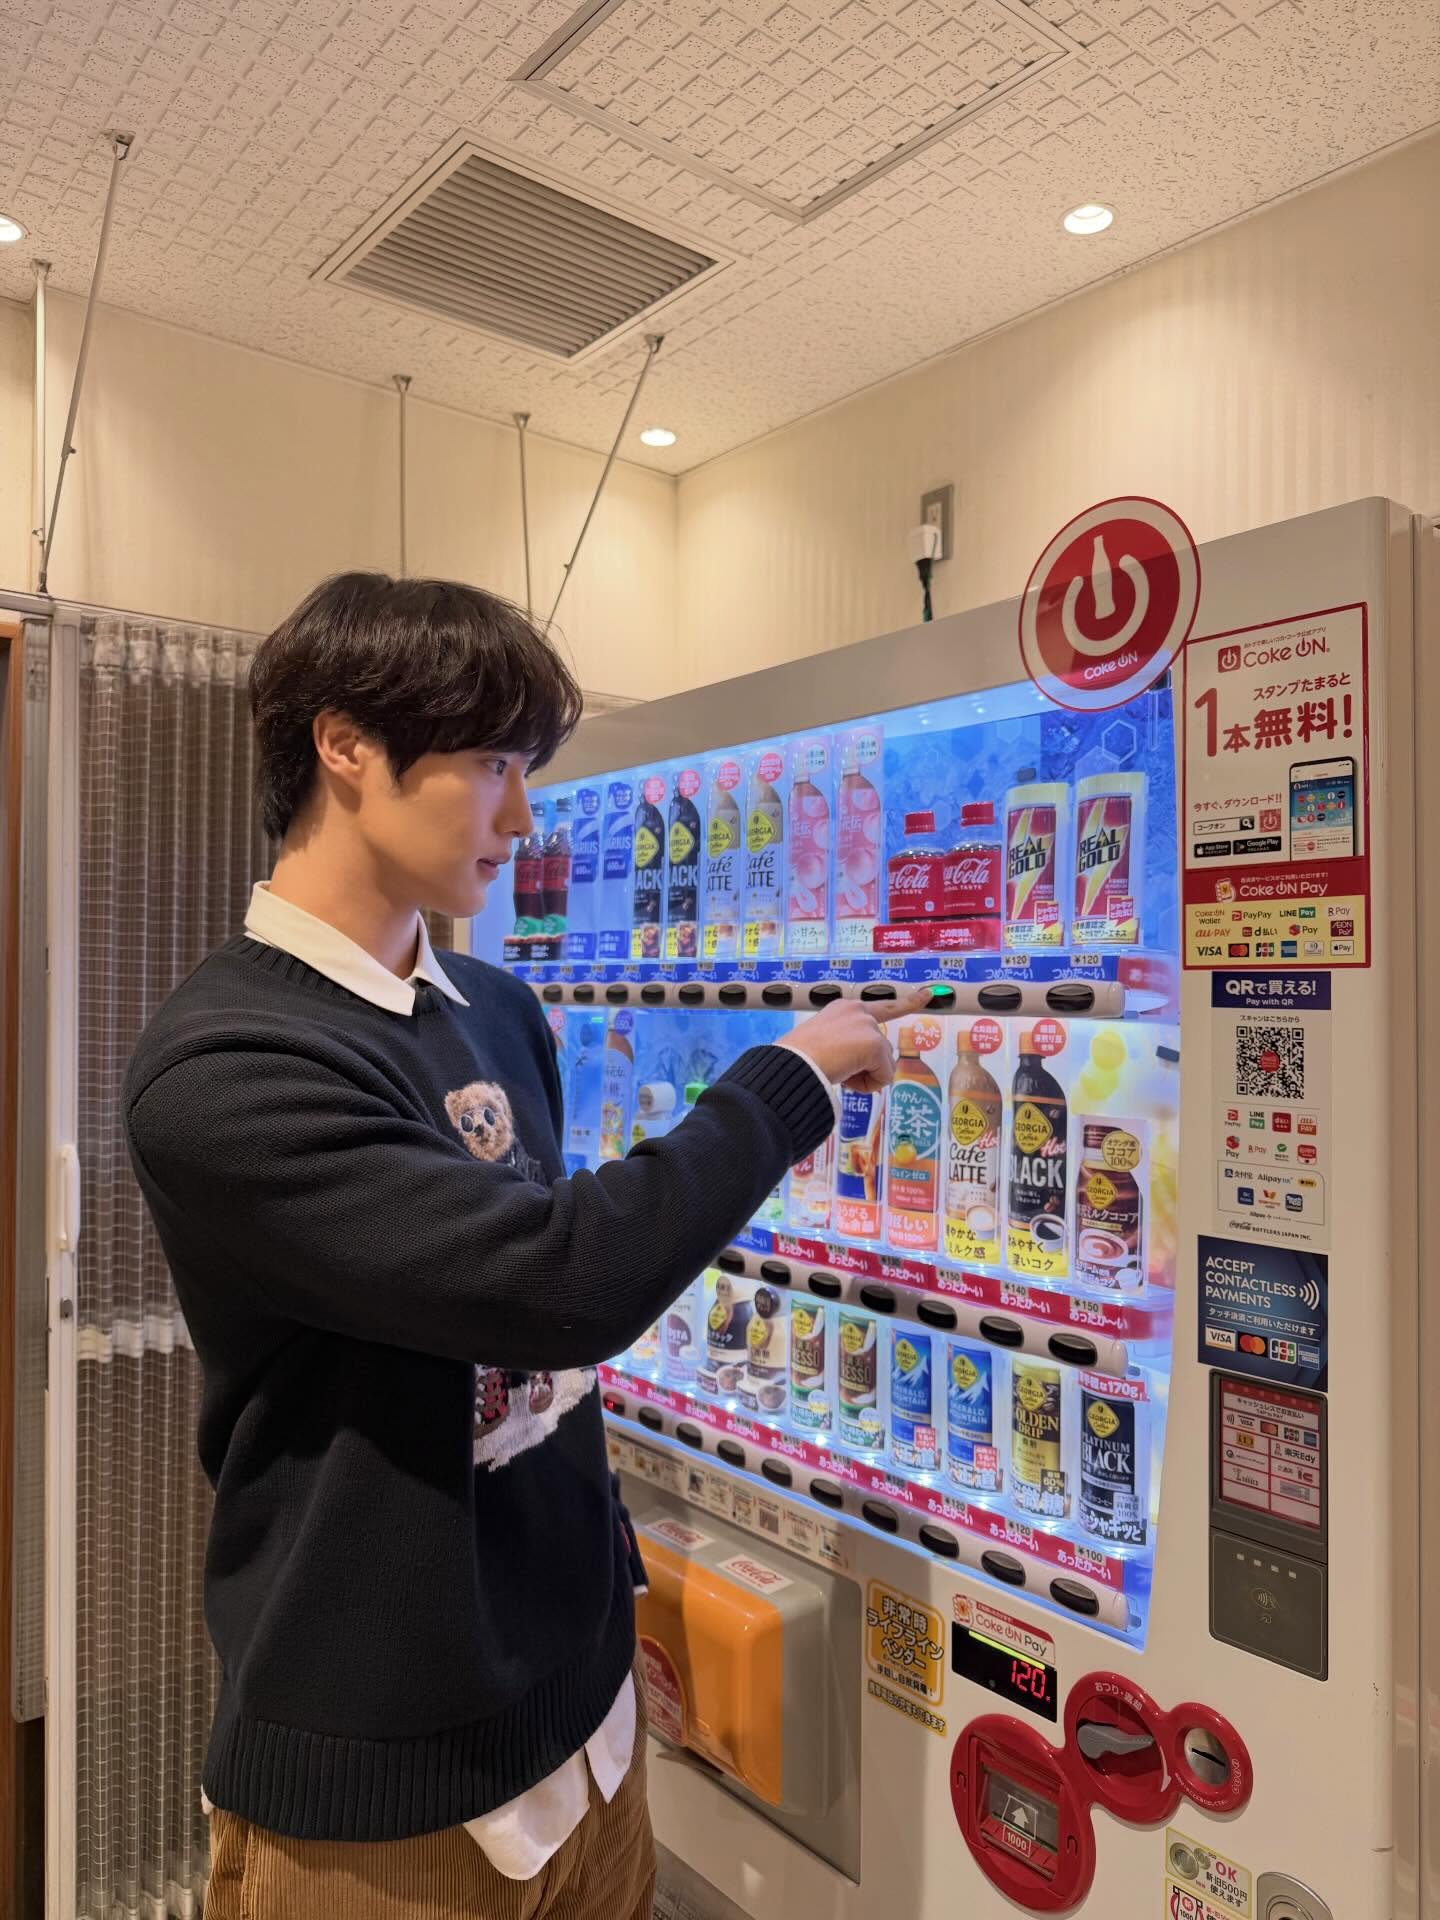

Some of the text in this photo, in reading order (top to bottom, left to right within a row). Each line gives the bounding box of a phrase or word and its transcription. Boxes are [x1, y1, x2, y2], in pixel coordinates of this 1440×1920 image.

[1083, 651, 1138, 680] Coke ON
[1244, 647, 1292, 668] Coke
[1253, 672, 1351, 701] スタンプたまると
[1196, 822, 1226, 832] コークオン
[1080, 826, 1121, 853] REAL
[1246, 838, 1279, 847] Google Play
[1009, 835, 1047, 861] REAL
[1008, 852, 1046, 880] GOLD
[1079, 843, 1121, 873] GOLD
[1239, 881, 1328, 897] Coke ON Pay
[1243, 911, 1272, 920] PayPay
[1300, 909, 1314, 917] Pay
[1336, 906, 1351, 916] Pay
[1214, 928, 1231, 937] PAY
[1302, 926, 1318, 936] Pay
[1196, 946, 1222, 956] VISA
[942, 959, 963, 967] ¥120
[1005, 954, 1028, 965] ¥120
[1074, 955, 1099, 965] ¥120
[1225, 979, 1316, 996] QRで買える!
[1246, 998, 1294, 1006] Pay with QR
[1240, 1014, 1301, 1023] スキャンはこちらから
[1106, 1146, 1136, 1158] ココア
[1225, 1150, 1240, 1159] Pay
[1110, 1156, 1134, 1168] 100%
[1257, 1174, 1281, 1184] Alipay
[1253, 1226, 1280, 1236] BOTTLERS
[1282, 1231, 1299, 1239] JAPAN
[1205, 1255, 1255, 1274] ACCEPT
[939, 1270, 960, 1281] ¥150
[1005, 1283, 1026, 1296] ¥140
[1205, 1270, 1297, 1298] CONTACTLESS
[1205, 1285, 1271, 1309] PAYMENTS
[1074, 1299, 1099, 1313] ¥150
[1210, 1331, 1232, 1344] VISA
[1015, 1407, 1060, 1432] OLDEN
[1240, 1418, 1253, 1427] VISA
[1018, 1422, 1044, 1439] DRIP
[1082, 1444, 1133, 1475] BLACK
[1284, 1447, 1316, 1463] 楽天Edy
[1009, 1521, 1031, 1536] ¥120
[1088, 1511, 1142, 1541] シャキッと
[1078, 1546, 1103, 1562] ¥100
[881, 1595, 928, 1636] 非常時
[866, 1607, 944, 1660] ライフライン
[975, 1613, 1003, 1634] Coke
[1004, 1626, 1022, 1644] ON
[1024, 1634, 1047, 1657] Pay
[881, 1637, 926, 1670] ベンダー
[1011, 1660, 1046, 1698] 120
[1006, 1831, 1027, 1851] 1000
[1215, 1861, 1237, 1883] OK
[1210, 1885, 1242, 1908] 使えます
